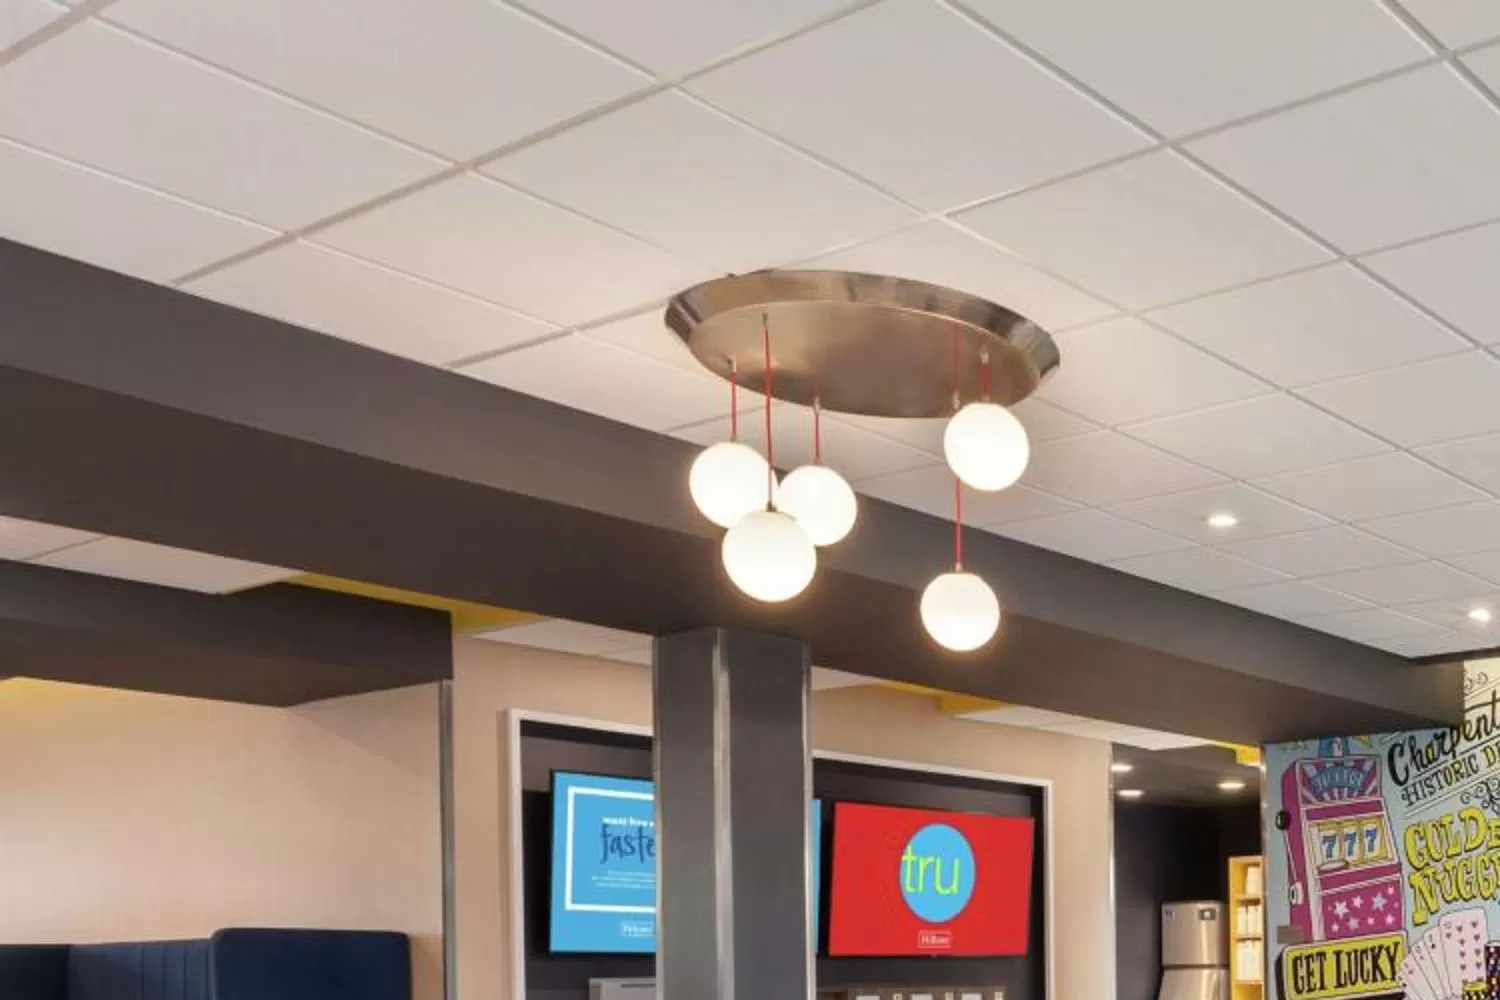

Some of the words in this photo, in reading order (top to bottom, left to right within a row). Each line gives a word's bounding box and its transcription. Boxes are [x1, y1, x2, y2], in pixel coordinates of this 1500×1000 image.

[1401, 752, 1480, 808] HISTORIC
[902, 844, 959, 895] tru
[1291, 951, 1326, 995] GET
[1334, 941, 1400, 989] LUCKY
